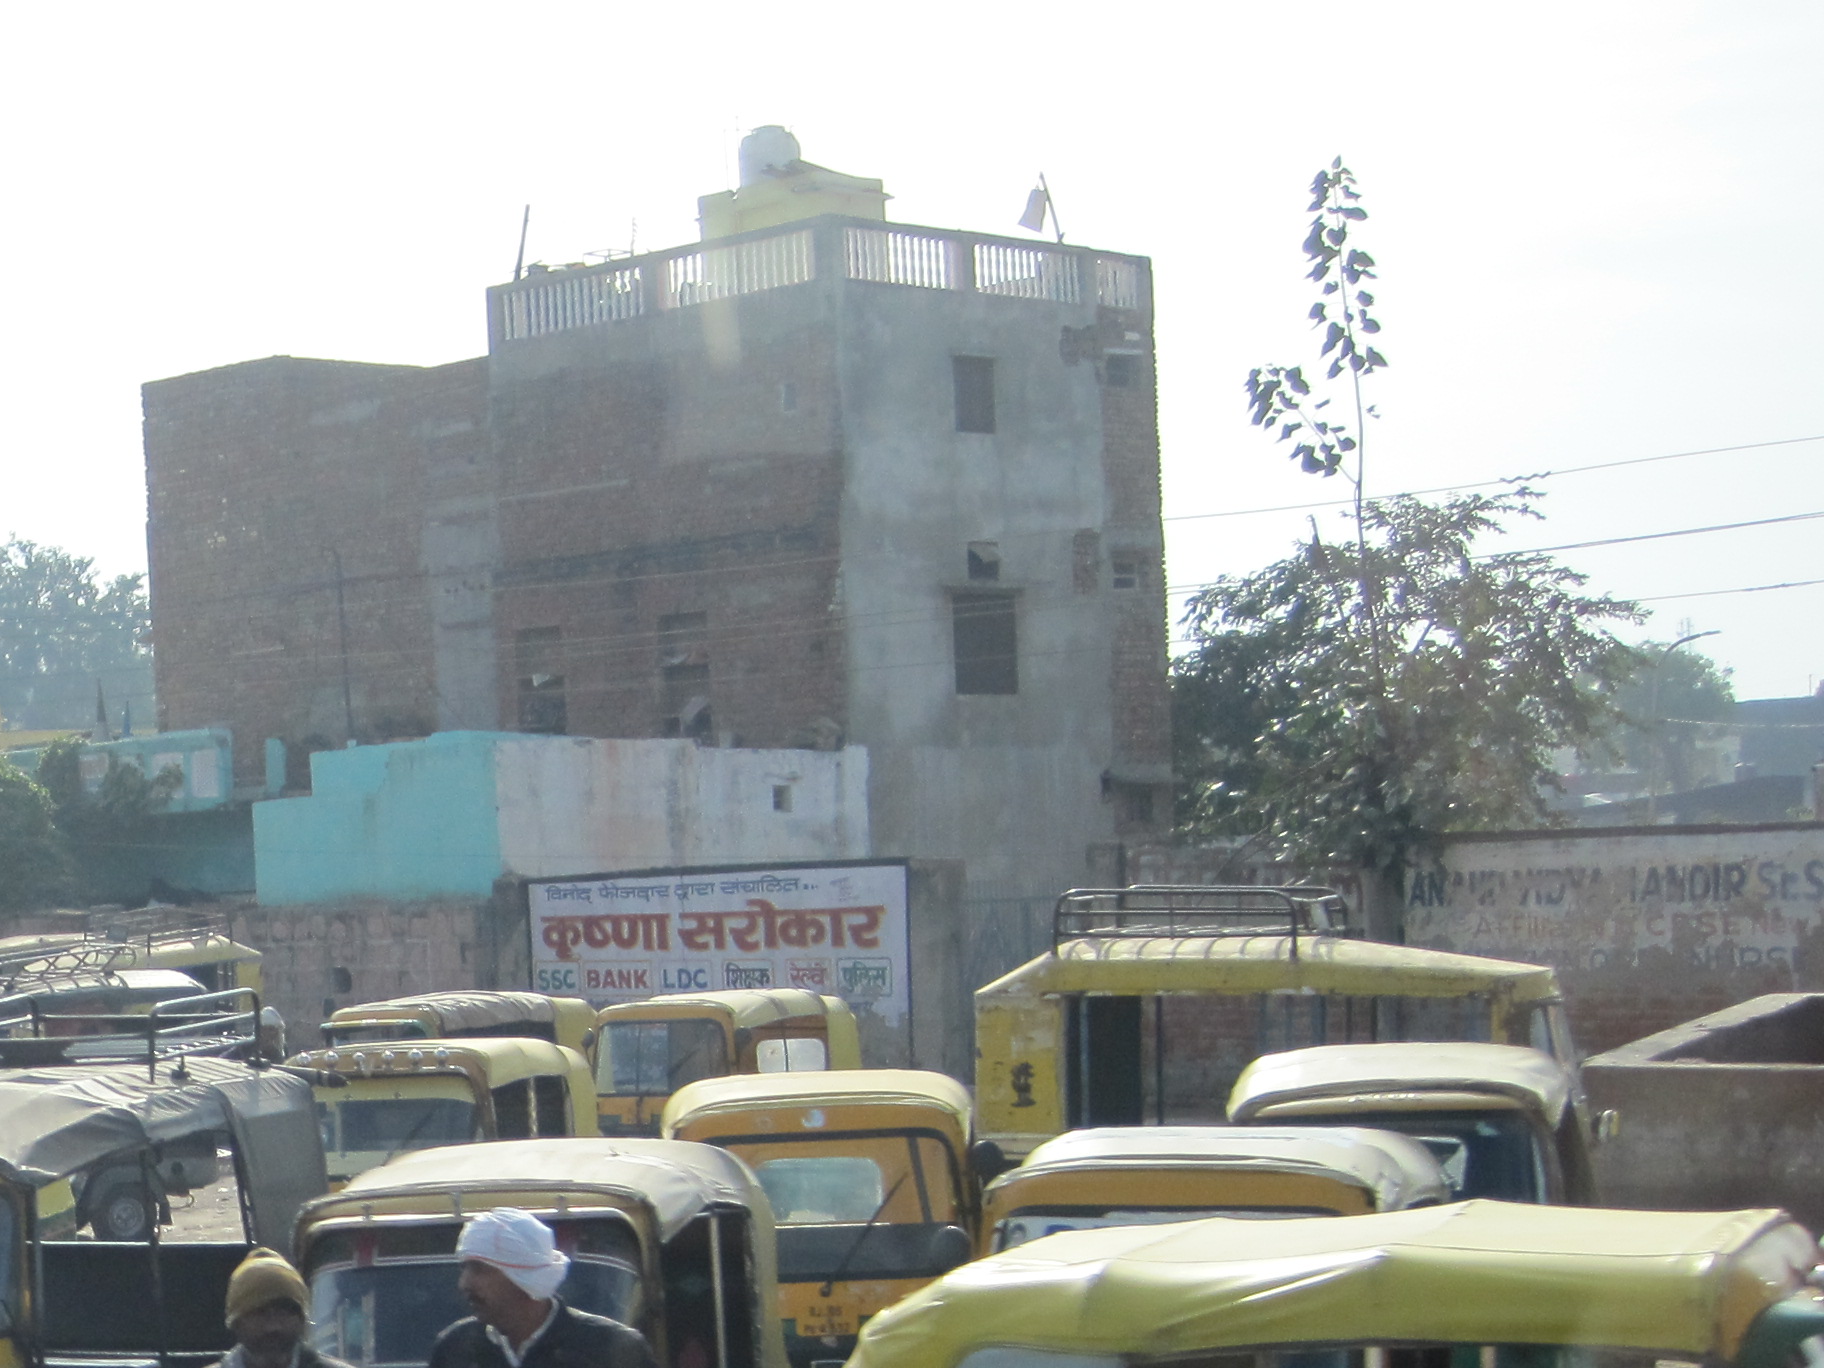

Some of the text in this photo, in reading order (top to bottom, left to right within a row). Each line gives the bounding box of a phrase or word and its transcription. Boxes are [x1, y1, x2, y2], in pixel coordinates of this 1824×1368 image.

[540, 899, 886, 959] कृष्णा सरोकार
[538, 969, 575, 991] SSC
[586, 968, 650, 989] BANK
[662, 967, 708, 989] LDC
